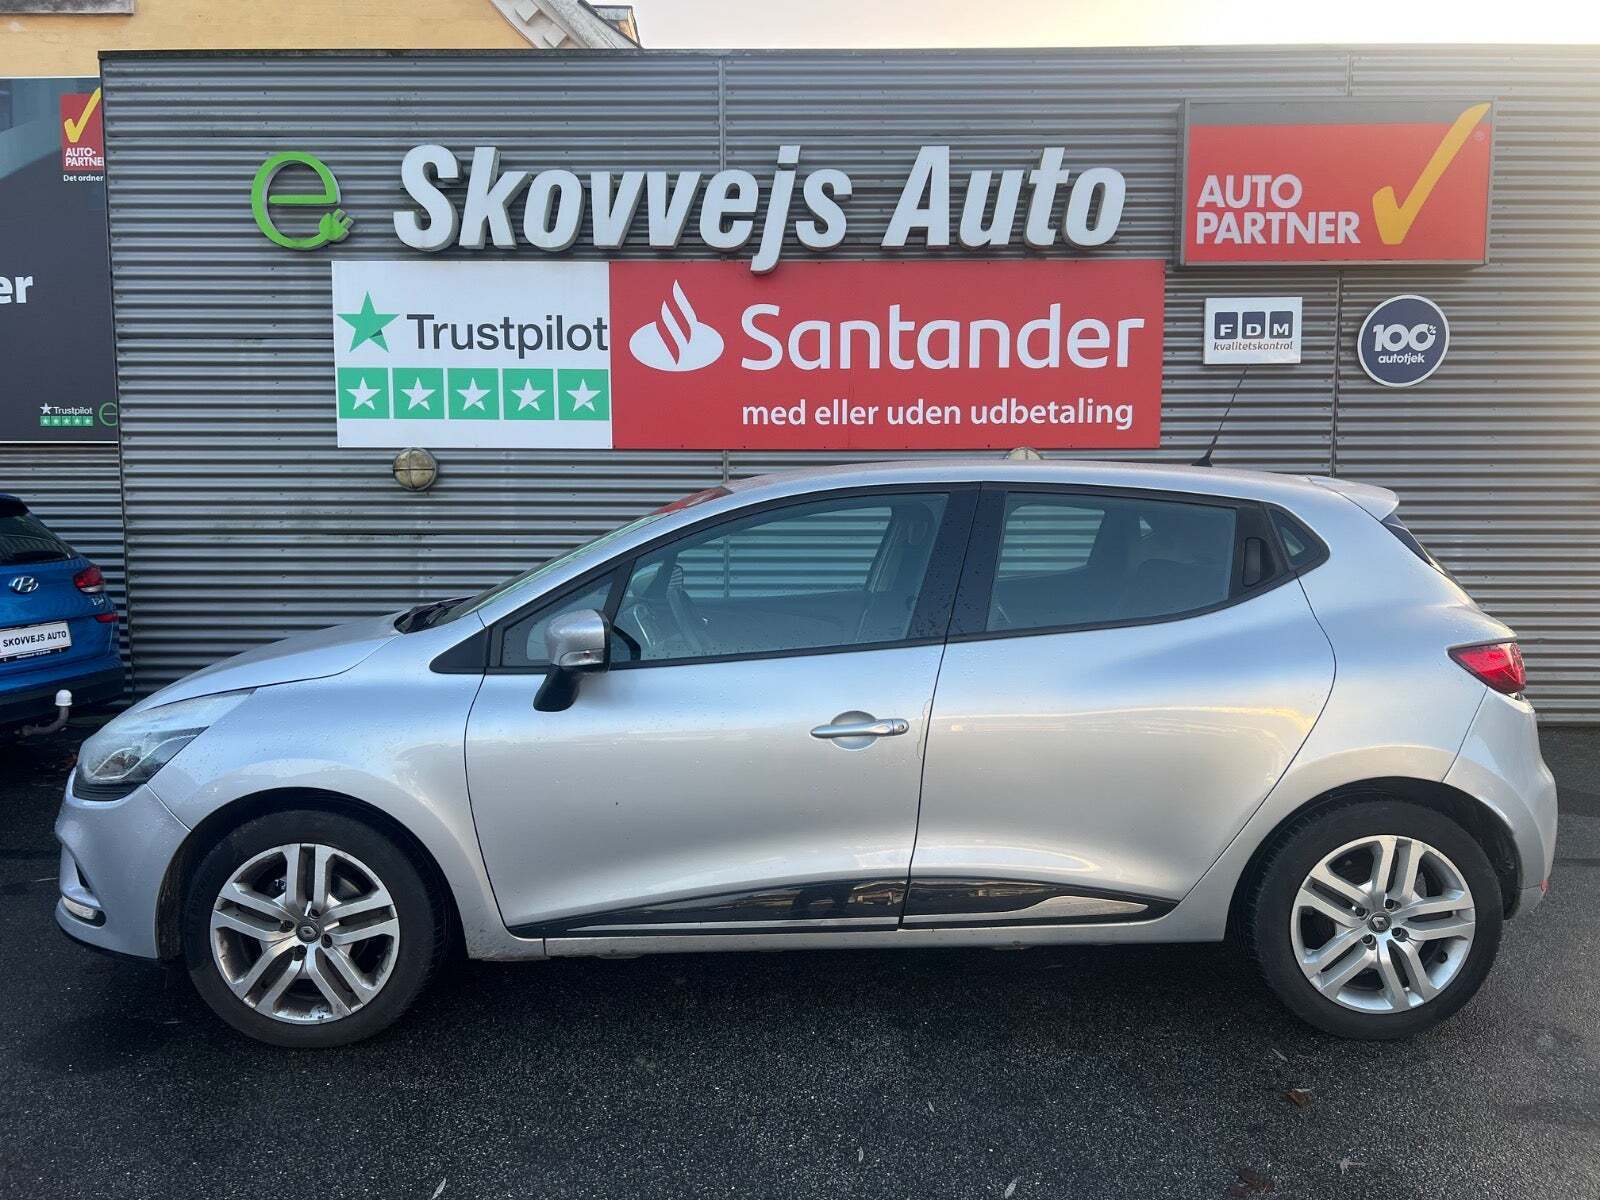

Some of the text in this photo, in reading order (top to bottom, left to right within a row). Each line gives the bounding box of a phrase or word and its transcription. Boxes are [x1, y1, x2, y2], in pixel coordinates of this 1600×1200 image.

[65, 156, 104, 167] PARTNE
[63, 173, 104, 182] Det ordner
[1197, 174, 1303, 209] AUTO
[393, 144, 1127, 274] Skovvejs Auto
[1196, 211, 1361, 244] PARTNER
[406, 313, 609, 359] Trustpilot
[741, 303, 1145, 370] Santander
[1219, 323, 1289, 336] FDM
[1213, 340, 1293, 351] kvalitetskontrol
[1378, 352, 1425, 365] autotjek
[54, 405, 93, 415] Trustpilot
[742, 398, 1134, 430] med eller uden udbetaling
[3, 630, 67, 647] SKOVVEJS AUTO
